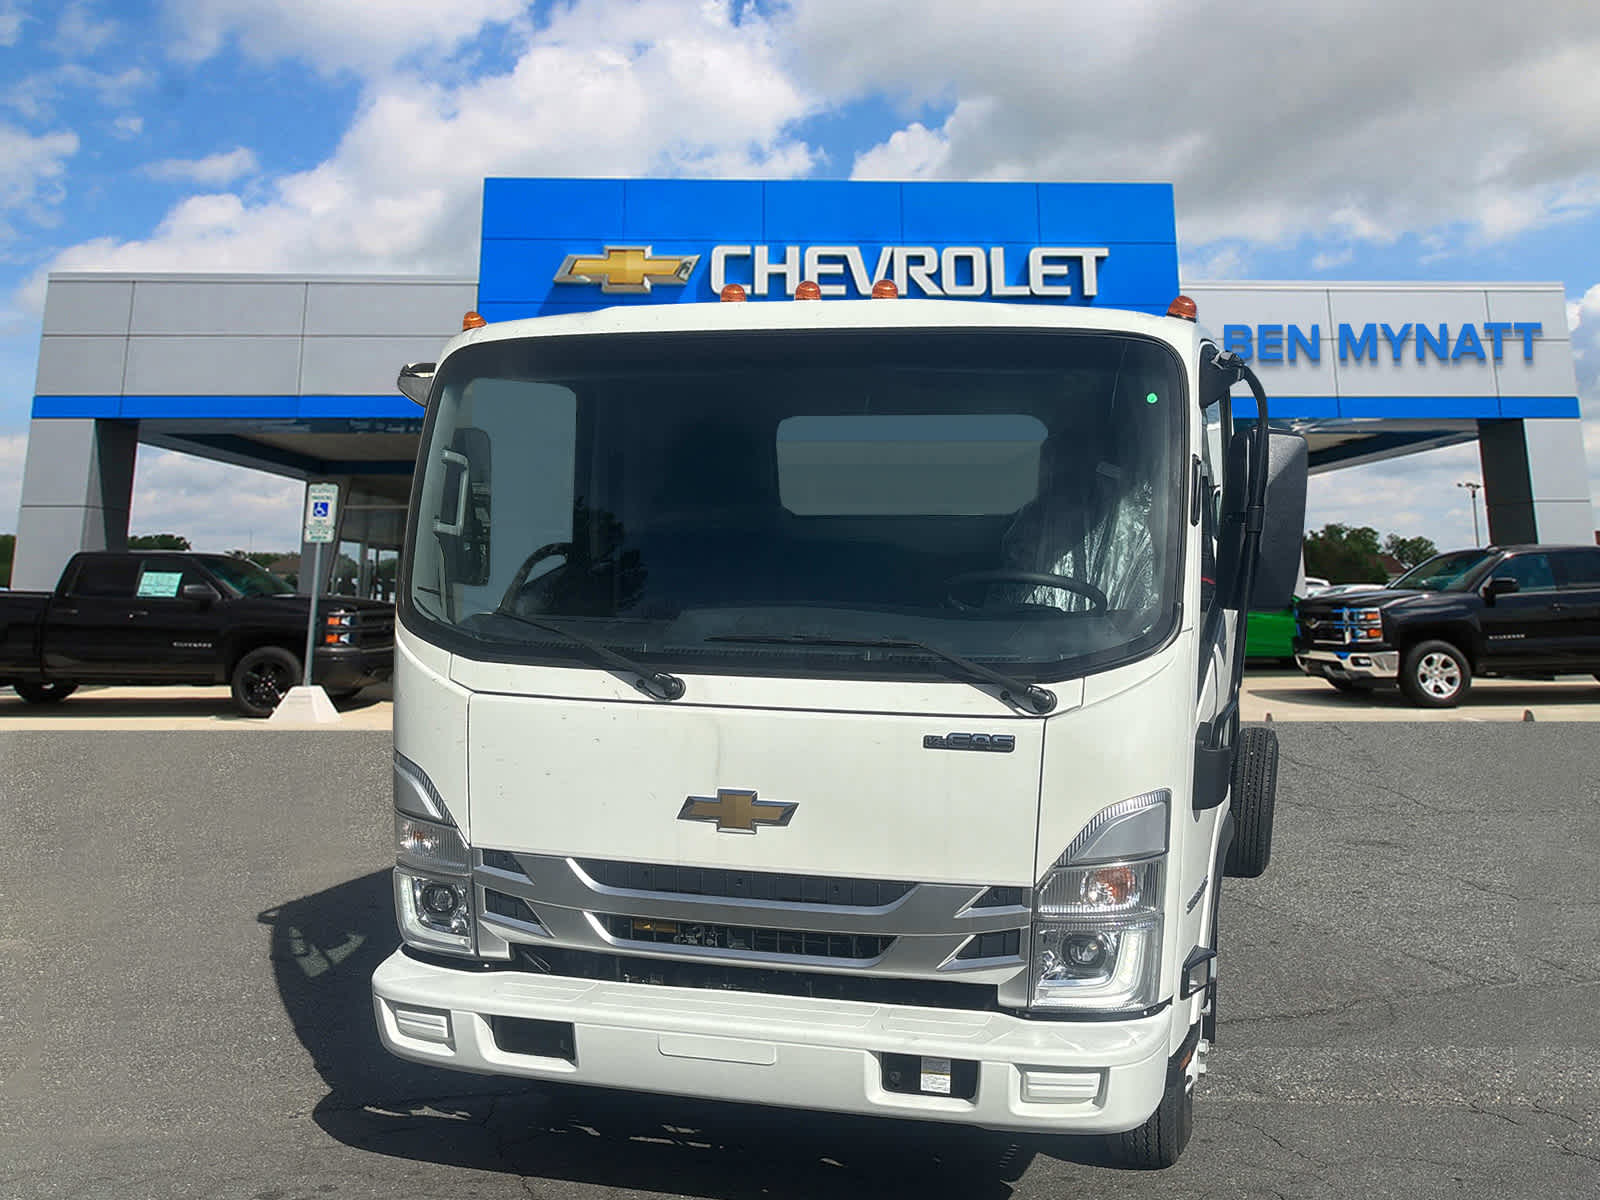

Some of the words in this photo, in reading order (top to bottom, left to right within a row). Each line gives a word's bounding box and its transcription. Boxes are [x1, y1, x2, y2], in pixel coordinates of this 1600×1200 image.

[710, 245, 1109, 297] CHEVROLET
[1223, 323, 1320, 364] BEN
[1338, 322, 1542, 364] MYNATT
